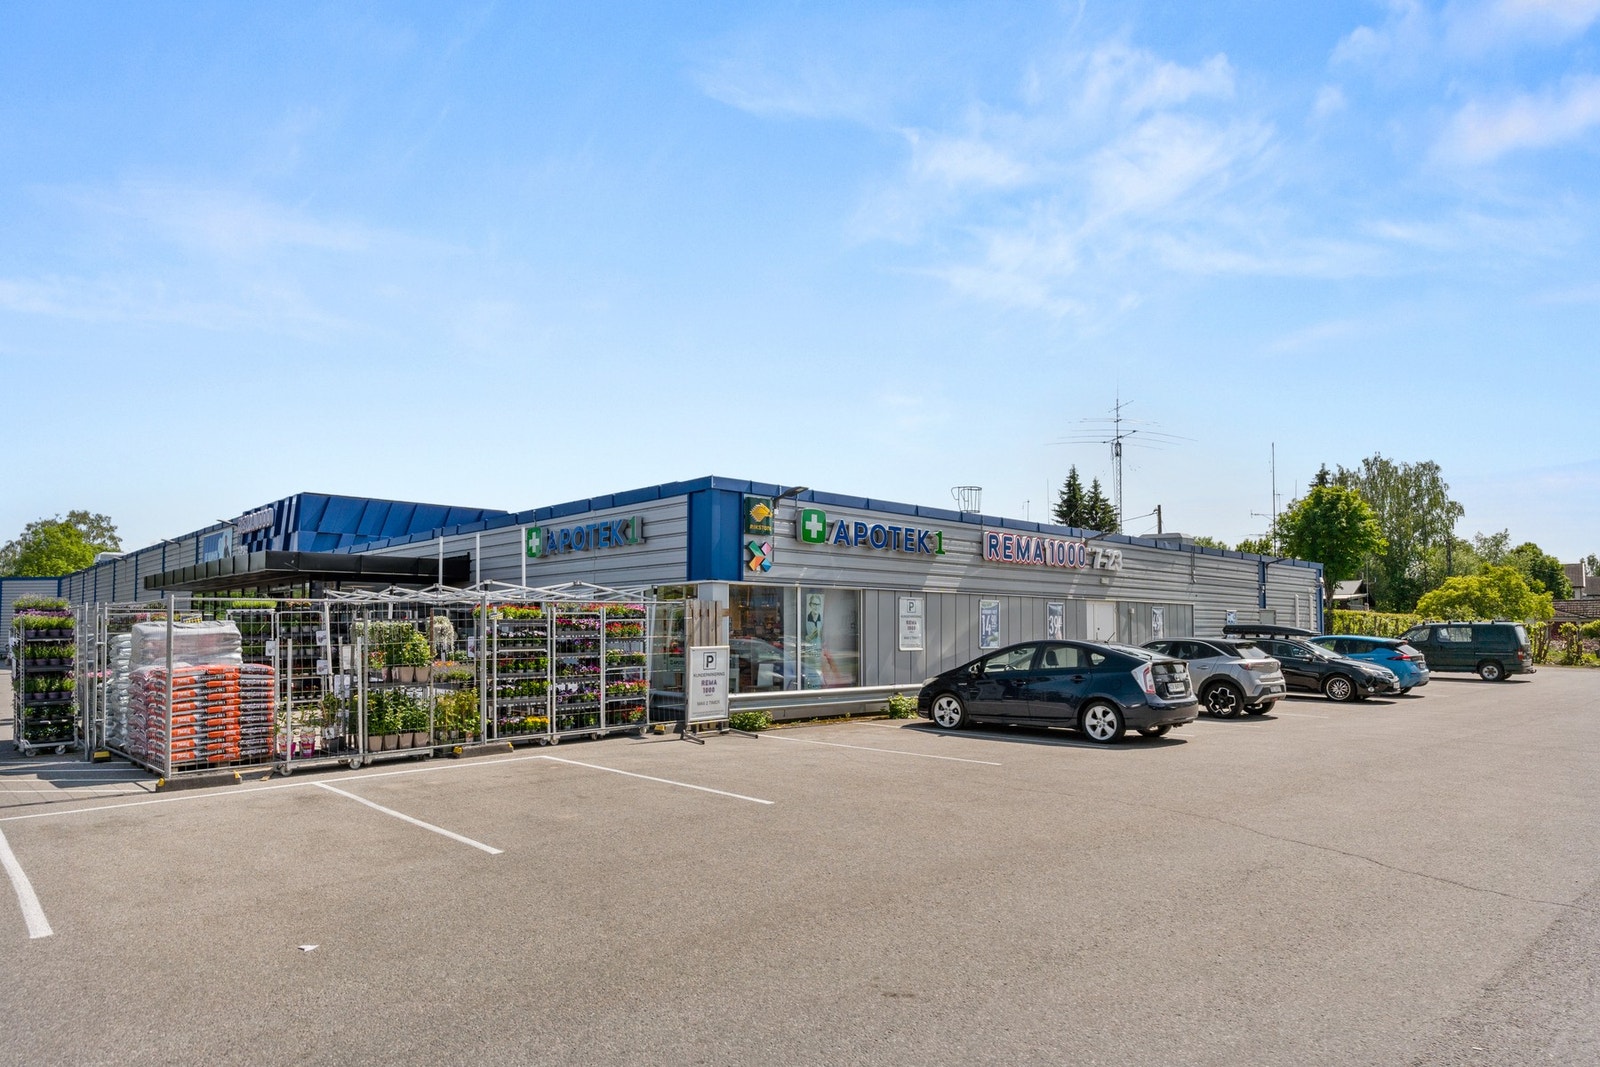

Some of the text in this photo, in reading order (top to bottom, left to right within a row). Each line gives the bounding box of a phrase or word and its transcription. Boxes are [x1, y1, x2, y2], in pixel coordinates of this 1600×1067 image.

[545, 519, 625, 556] APOTEK
[833, 519, 946, 555] APOTEK 1
[984, 531, 1087, 569] REMA 1000
[706, 655, 714, 668] P
